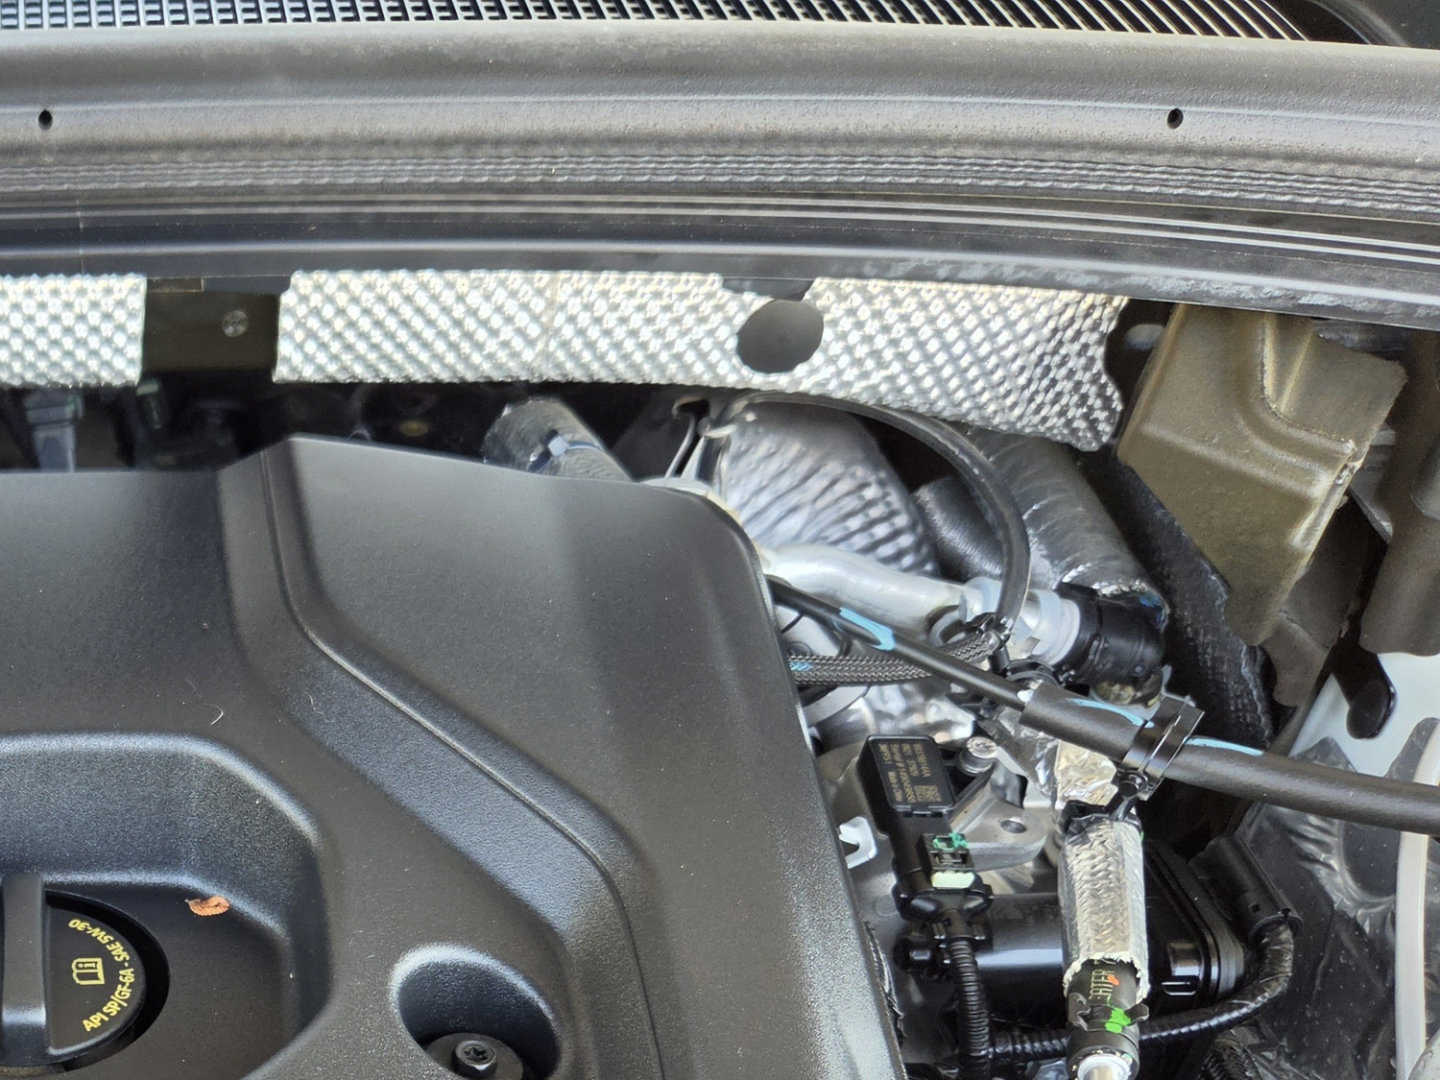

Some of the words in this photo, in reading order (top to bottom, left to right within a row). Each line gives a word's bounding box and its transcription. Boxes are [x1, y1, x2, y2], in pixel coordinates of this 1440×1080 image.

[68, 919, 114, 944] 5W-30
[106, 941, 130, 962] SAE
[102, 968, 135, 1016] SP/GF-6A
[82, 1012, 109, 1032] API
